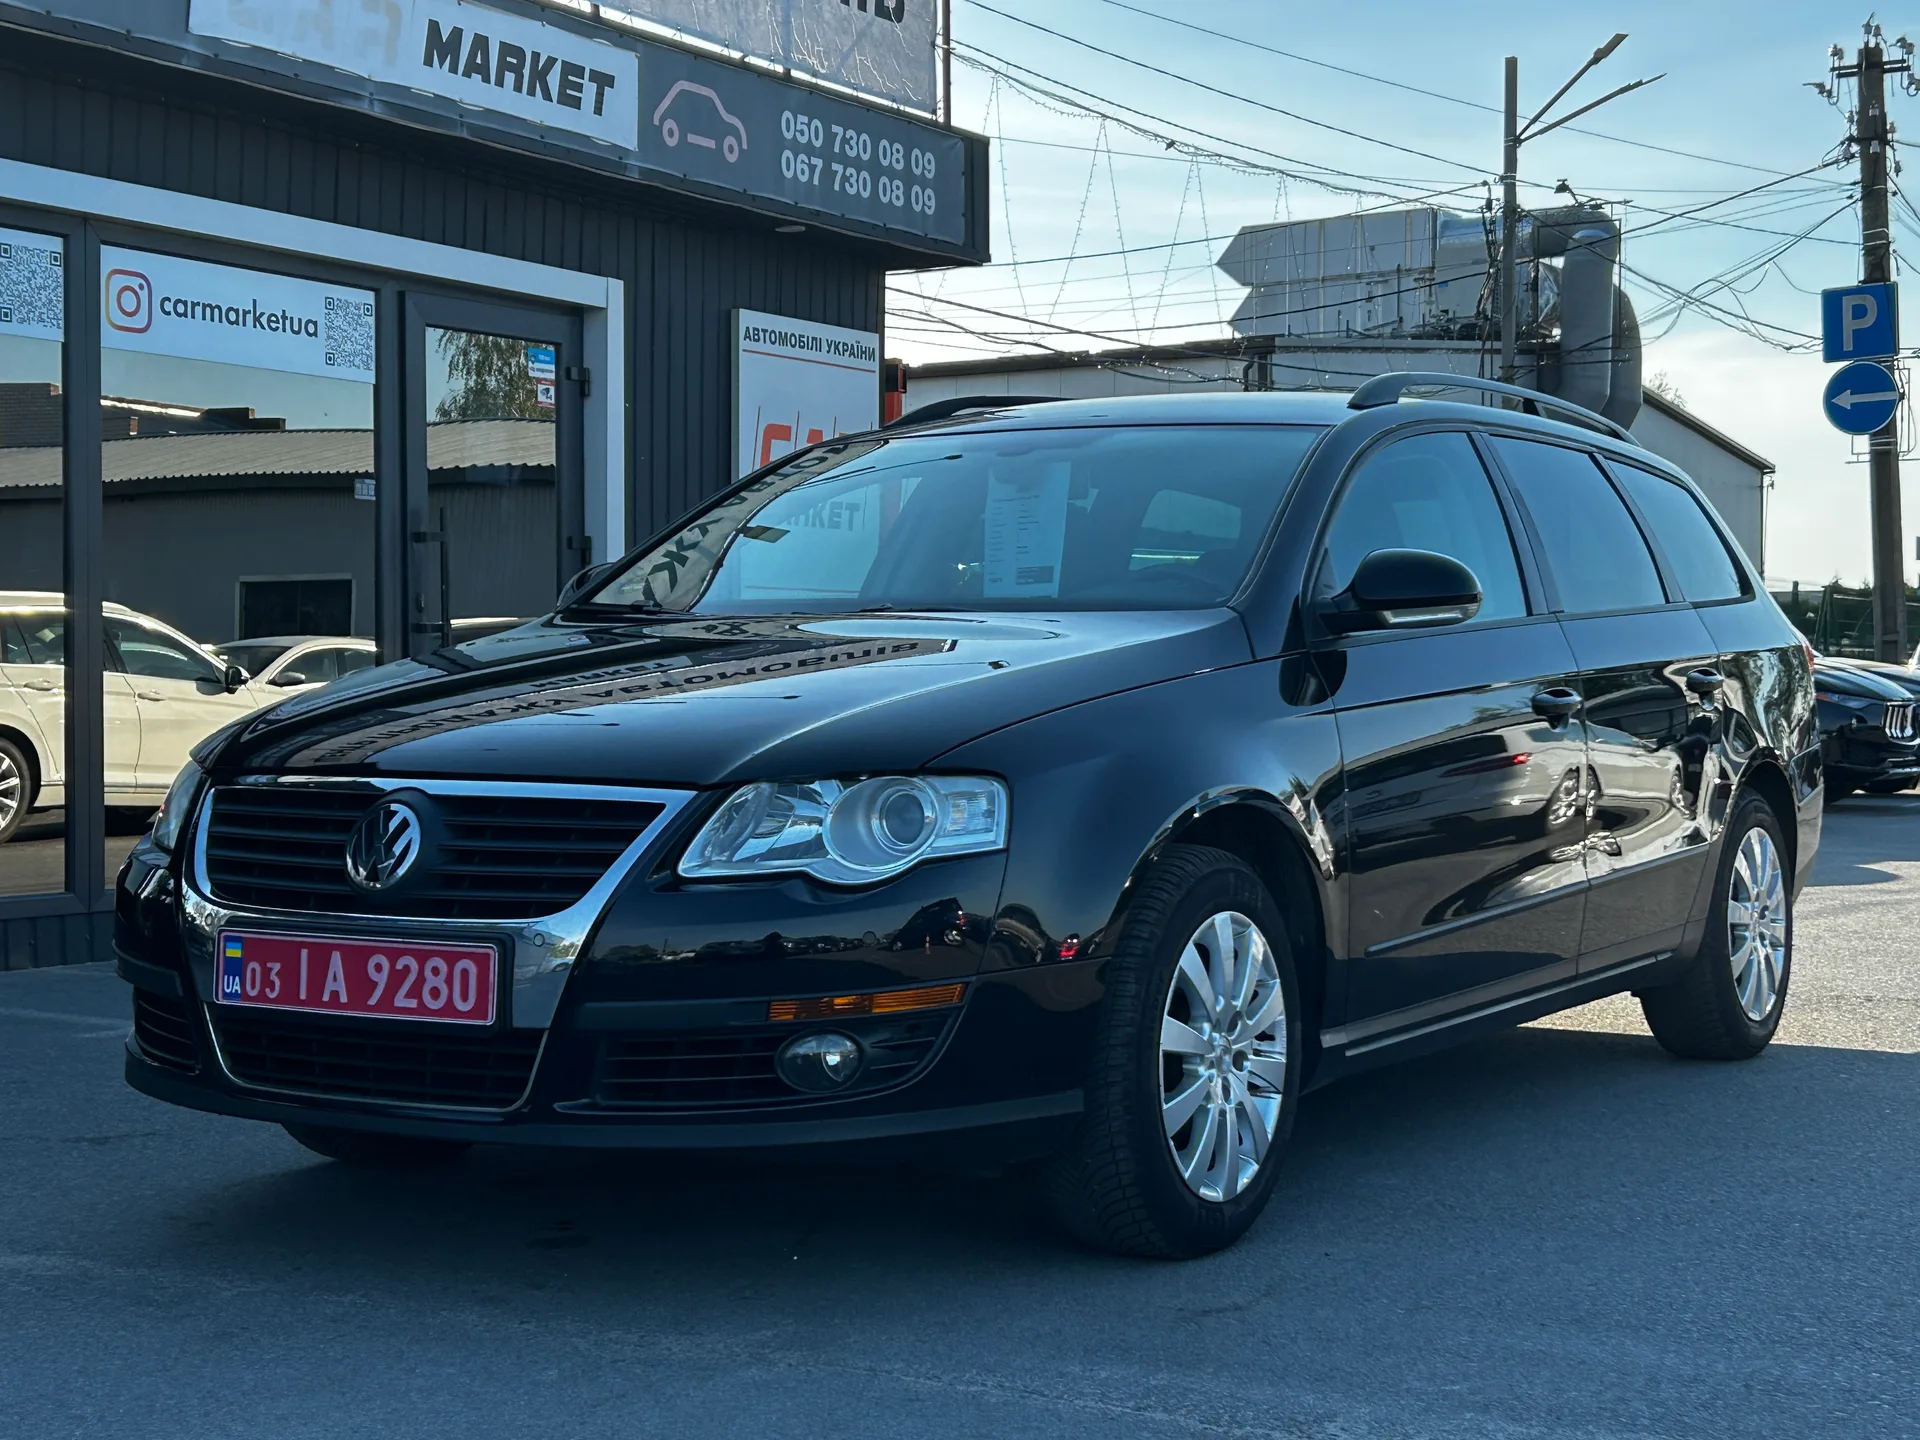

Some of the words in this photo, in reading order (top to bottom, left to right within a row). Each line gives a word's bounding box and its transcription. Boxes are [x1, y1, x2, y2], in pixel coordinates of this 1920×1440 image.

[423, 19, 615, 116] MARKET
[781, 110, 823, 148] 050
[831, 123, 871, 161] 730
[878, 138, 904, 170] 08
[911, 148, 936, 179] 09
[781, 149, 824, 185] 067
[831, 164, 871, 198] 730
[878, 176, 904, 207] 08
[911, 184, 936, 215] 09
[160, 296, 318, 337] carmarketua
[743, 326, 822, 353] АВТОМОБІЛІ
[826, 339, 876, 362] УКРАЇНИ
[1842, 294, 1878, 351] P
[224, 975, 241, 994] UA
[246, 962, 281, 998] 03
[367, 954, 477, 1012] 9280
